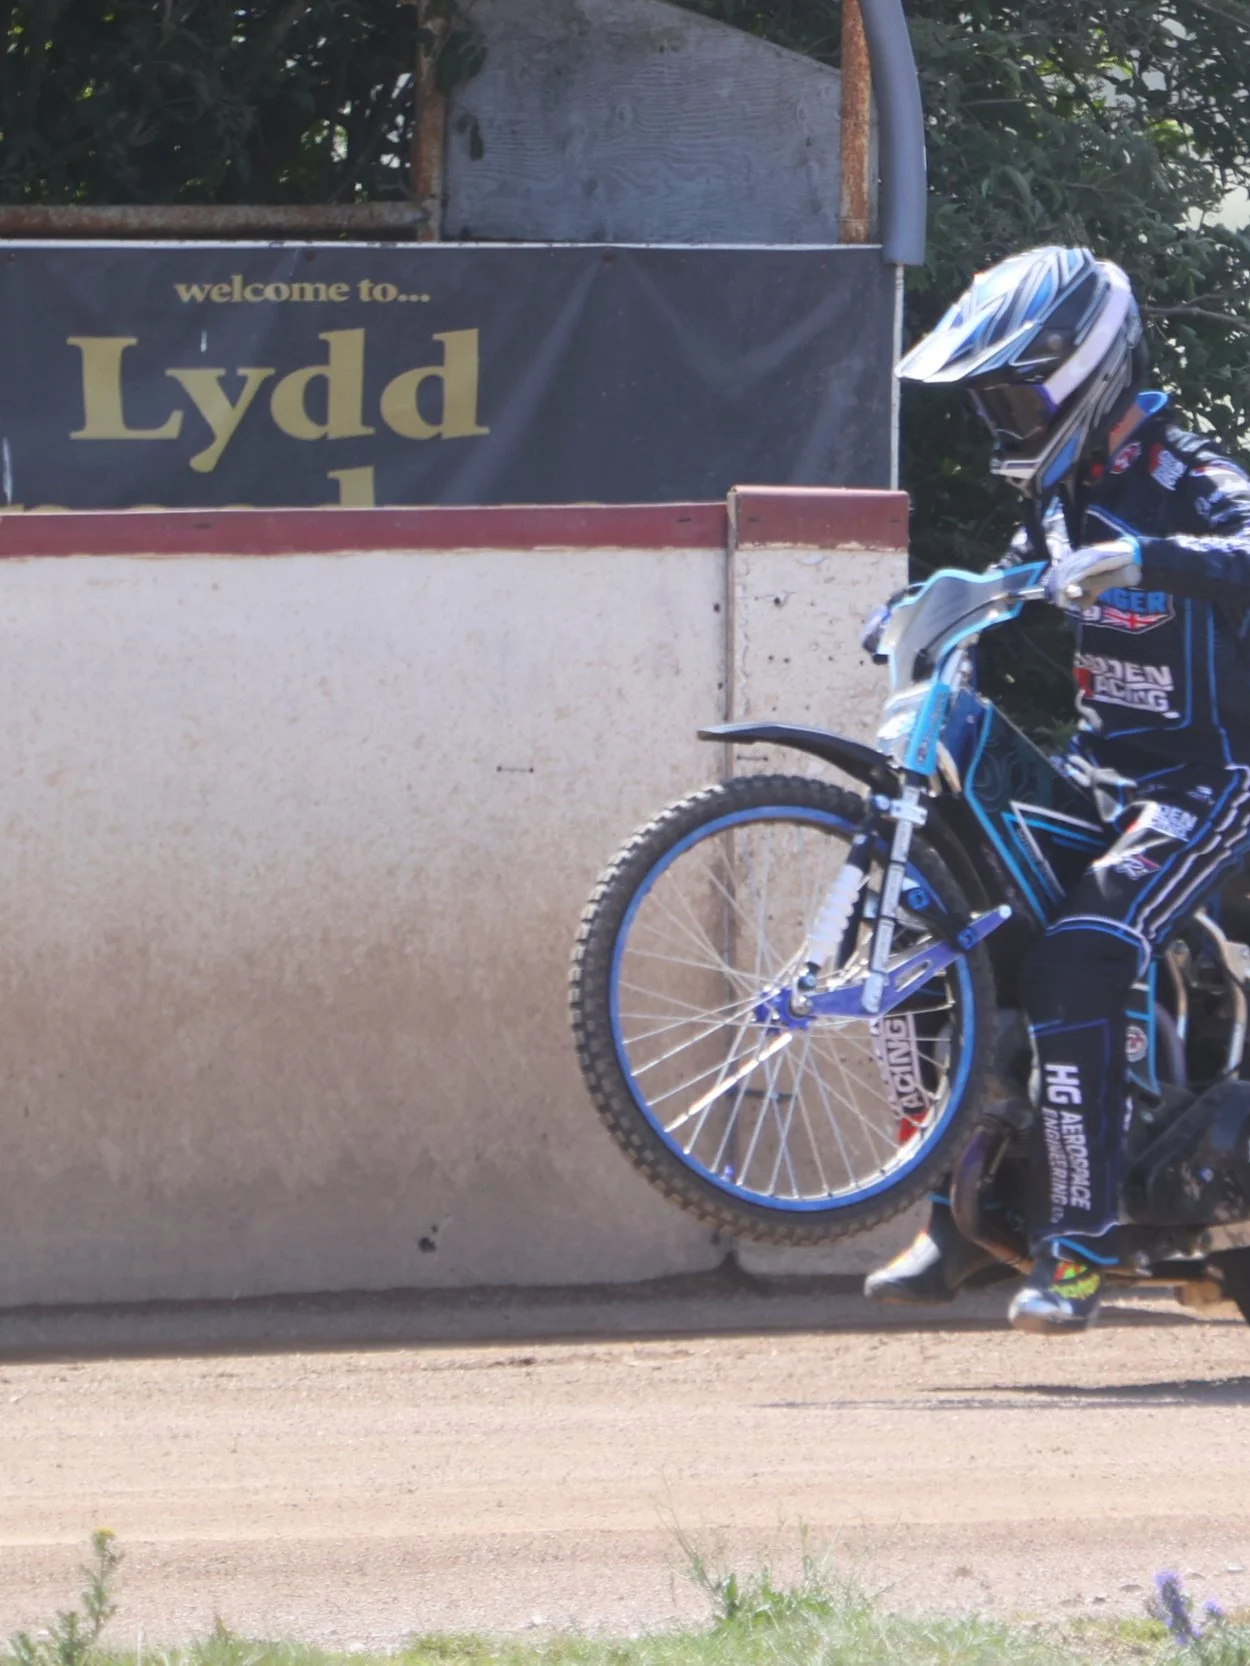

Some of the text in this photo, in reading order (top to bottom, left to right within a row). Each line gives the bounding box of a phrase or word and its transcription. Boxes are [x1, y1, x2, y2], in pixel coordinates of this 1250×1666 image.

[174, 274, 431, 303] welcome to...
[66, 327, 491, 473] Lydd
[1041, 1107, 1068, 1206] ENGINEERING
[1044, 1063, 1092, 1211] HG AEROSPACE
